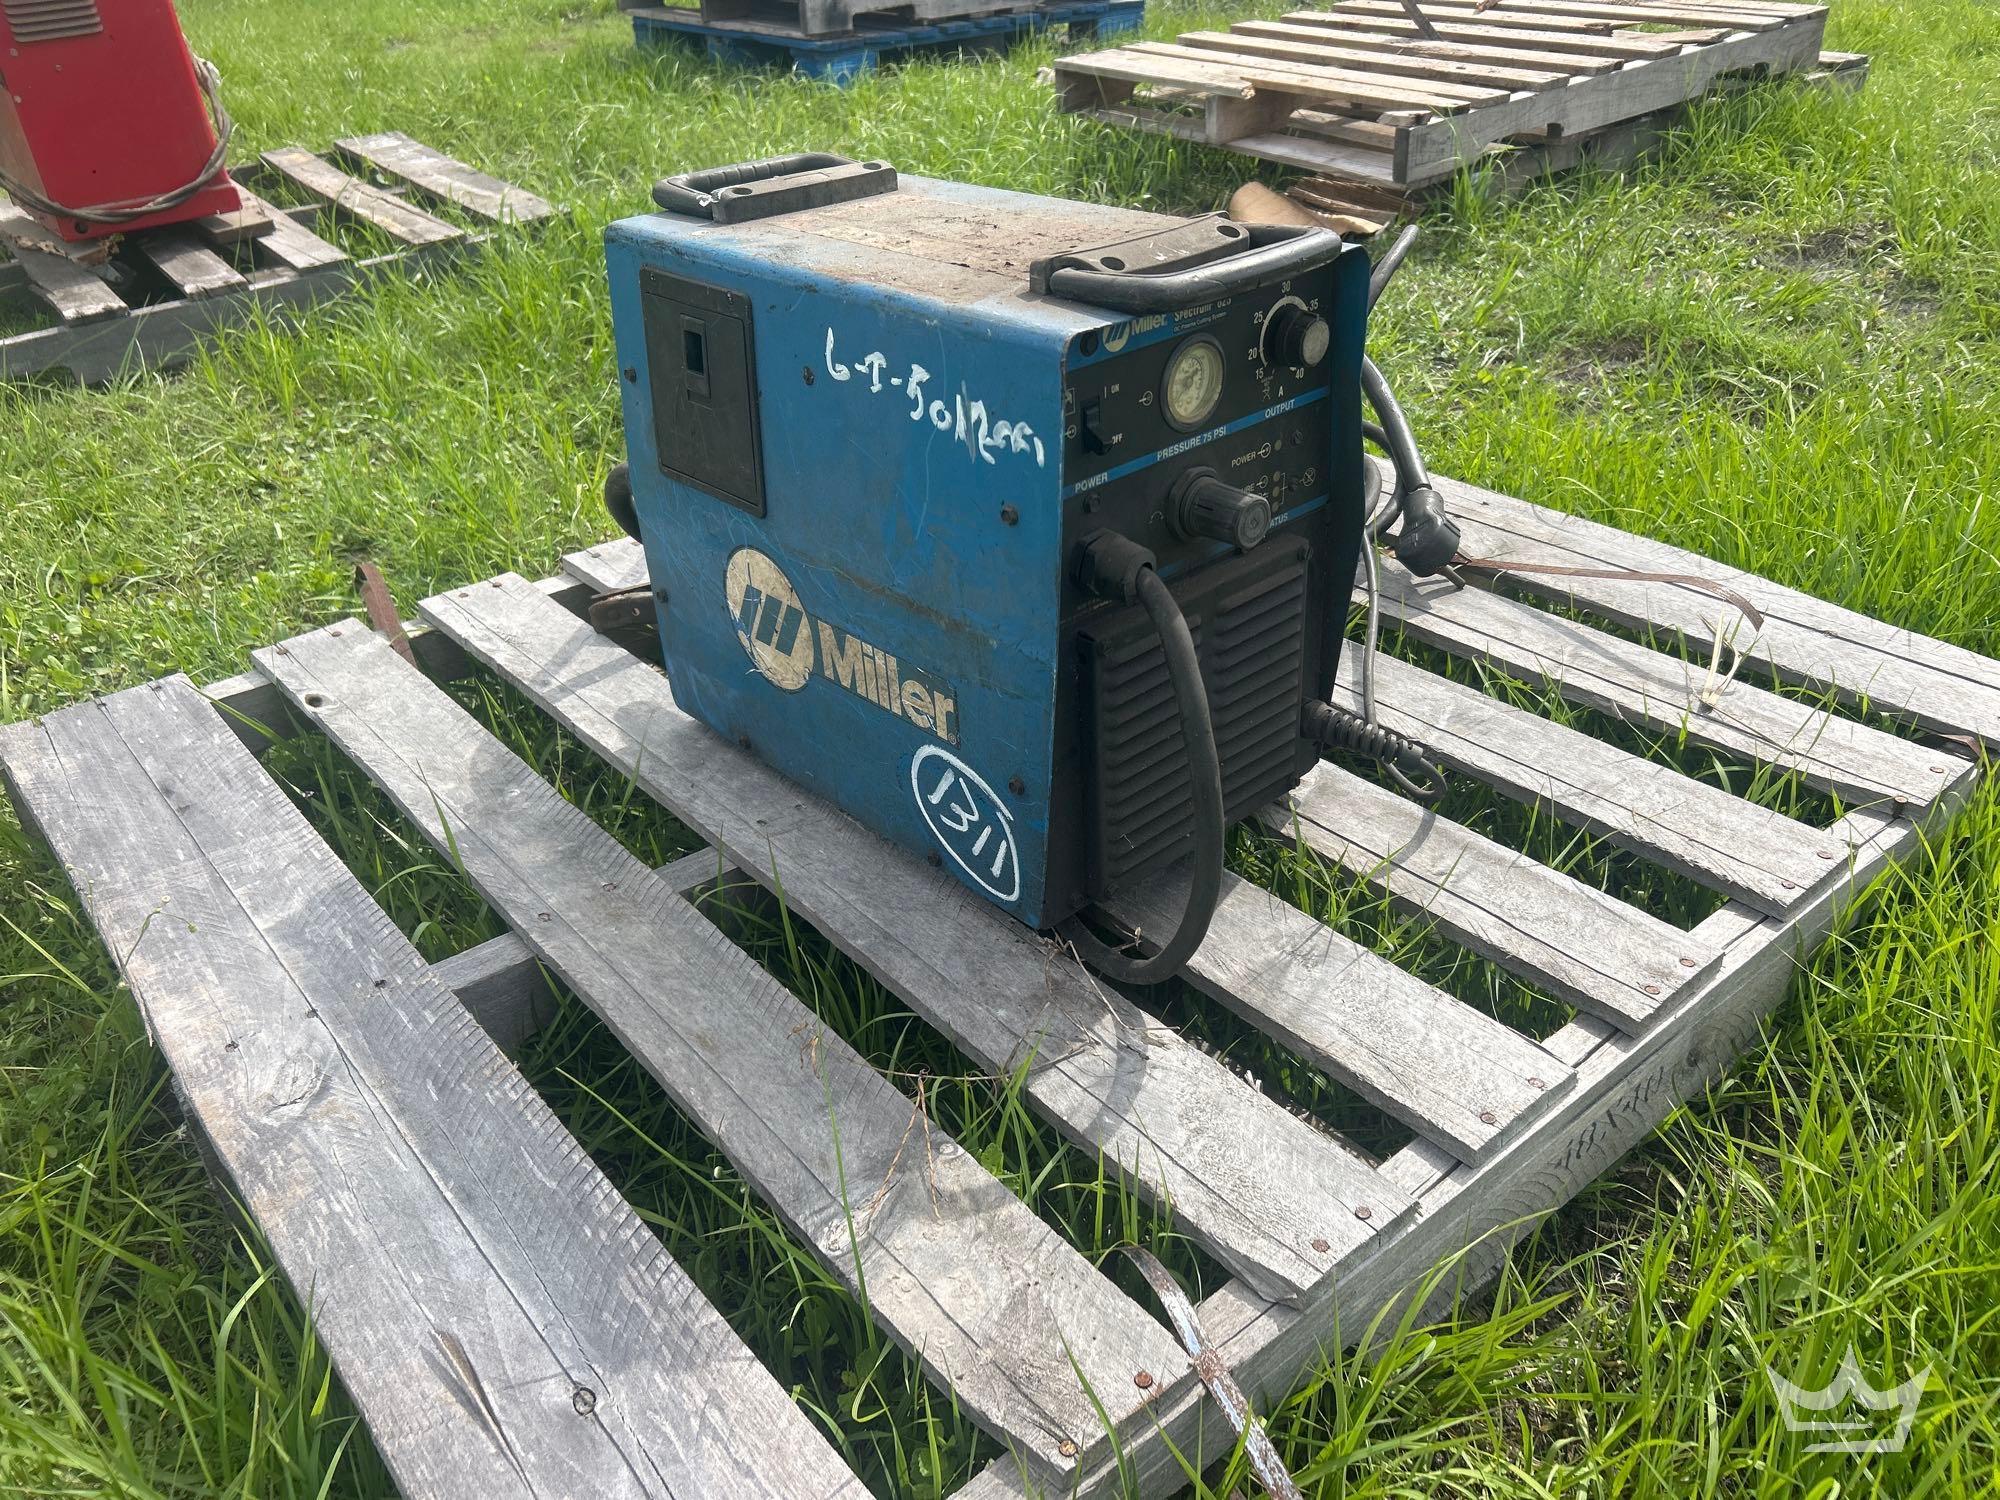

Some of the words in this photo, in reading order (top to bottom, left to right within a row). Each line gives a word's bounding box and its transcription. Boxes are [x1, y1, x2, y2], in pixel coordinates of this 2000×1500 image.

[1281, 280, 1291, 293] 30
[1309, 298, 1319, 312] 35
[1253, 311, 1263, 324] 25
[1248, 347, 1258, 360] 20
[1255, 367, 1264, 380] 15
[1295, 367, 1305, 380] 40
[1110, 383, 1120, 394] ON
[1278, 385, 1284, 398] A
[1264, 399, 1296, 419] OUTPUT
[1157, 435, 1201, 461] PRESSURE
[1203, 430, 1213, 443] 75
[1213, 425, 1227, 440] PSI
[1231, 451, 1257, 468] POWER
[1074, 472, 1109, 493] POWER
[817, 619, 955, 741] Miller
